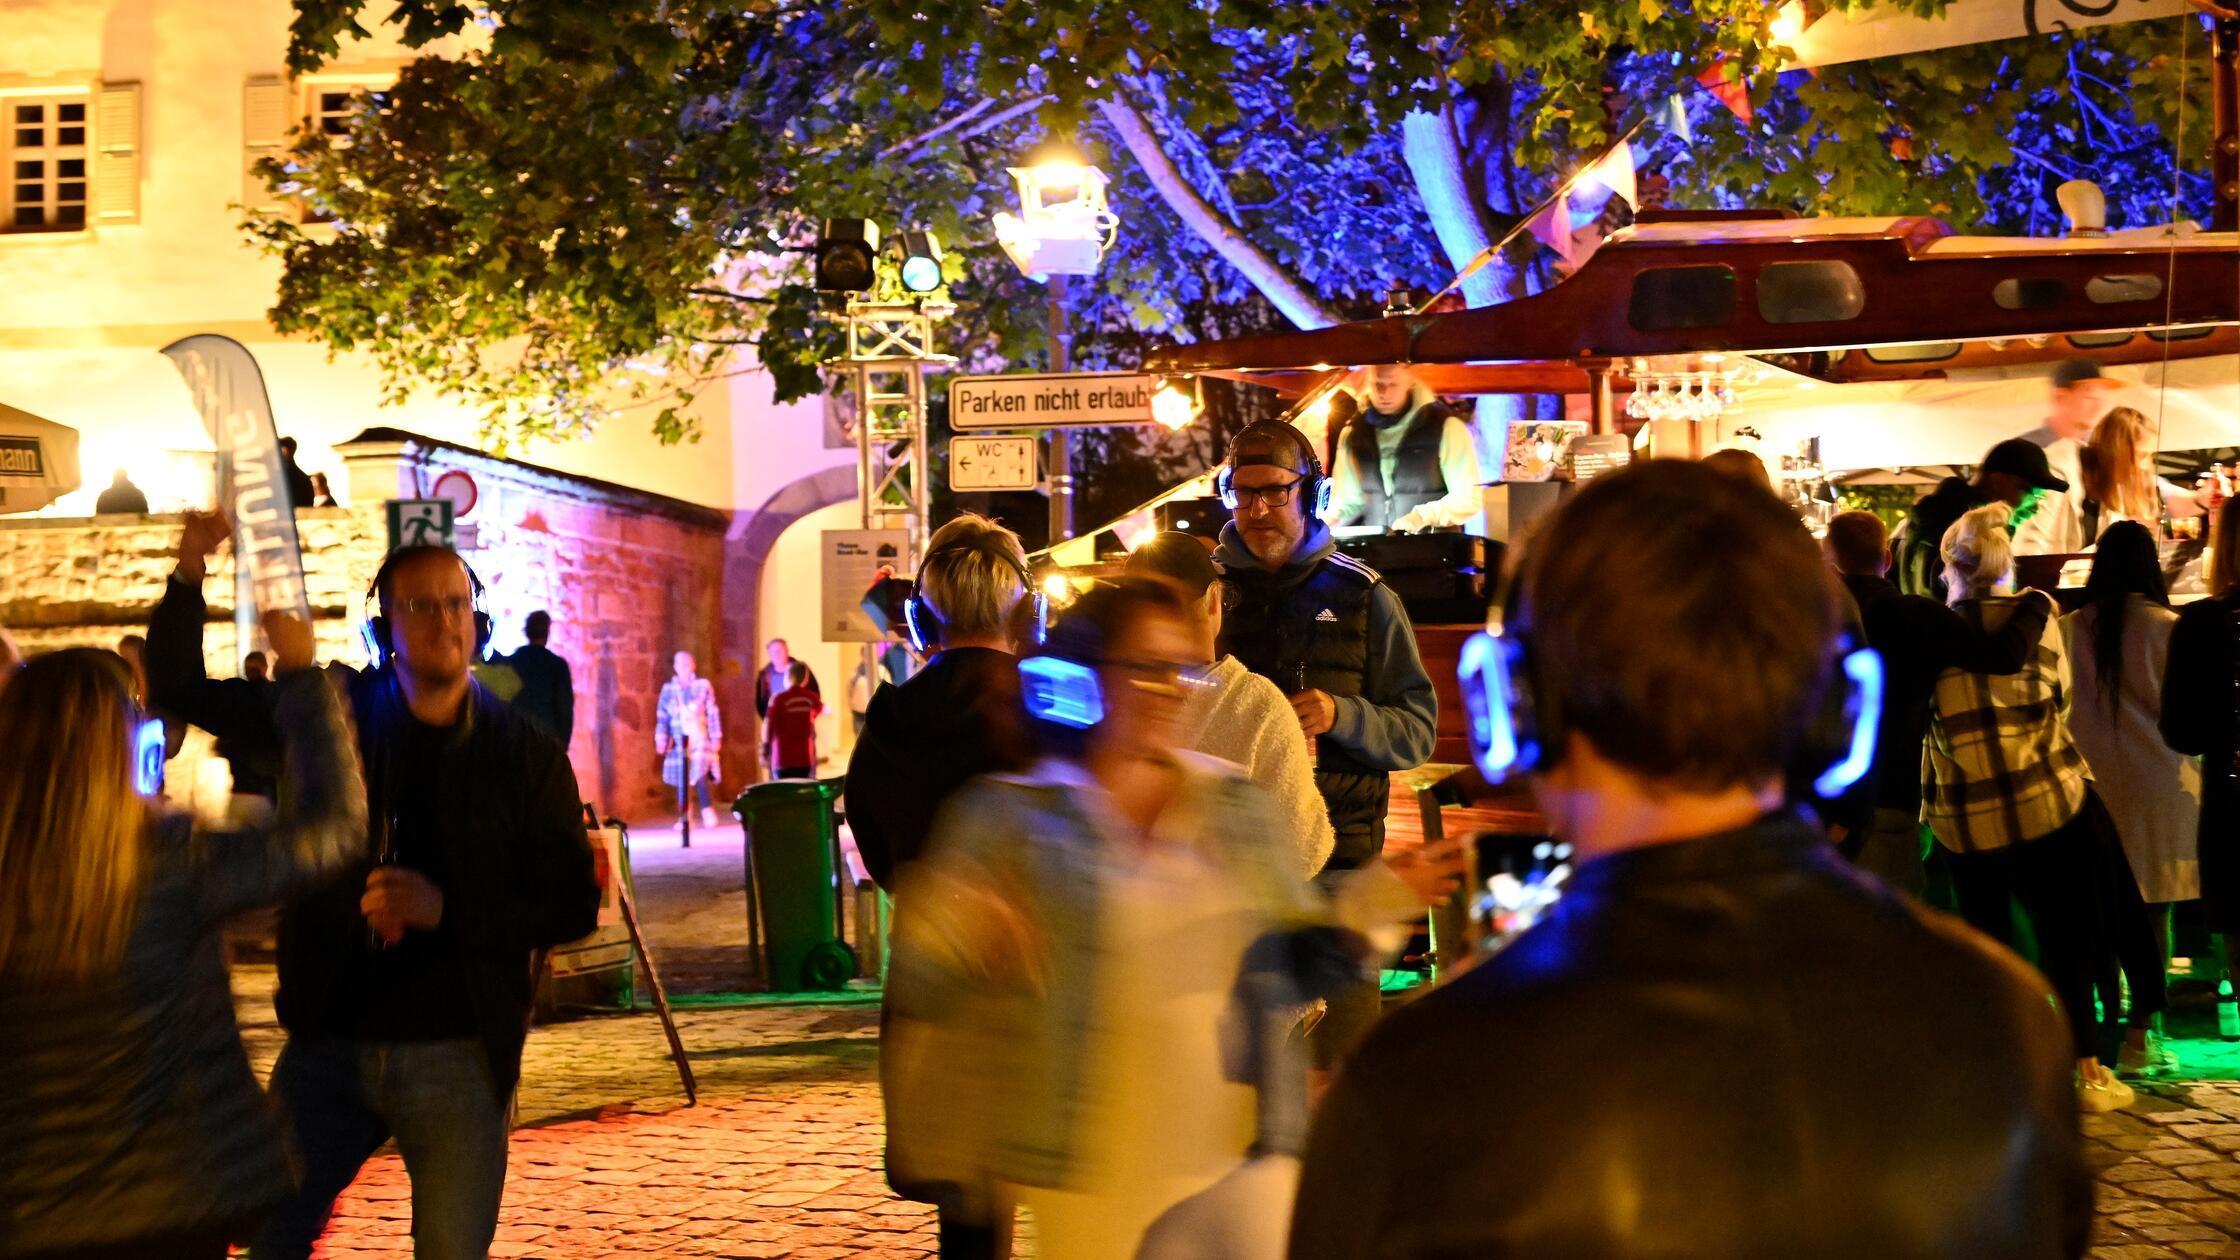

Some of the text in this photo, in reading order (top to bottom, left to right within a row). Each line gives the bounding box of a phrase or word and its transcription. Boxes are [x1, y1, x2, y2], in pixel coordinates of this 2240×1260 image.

[960, 384, 1151, 414] Parken nicht erlaub
[976, 442, 1002, 457] WC
